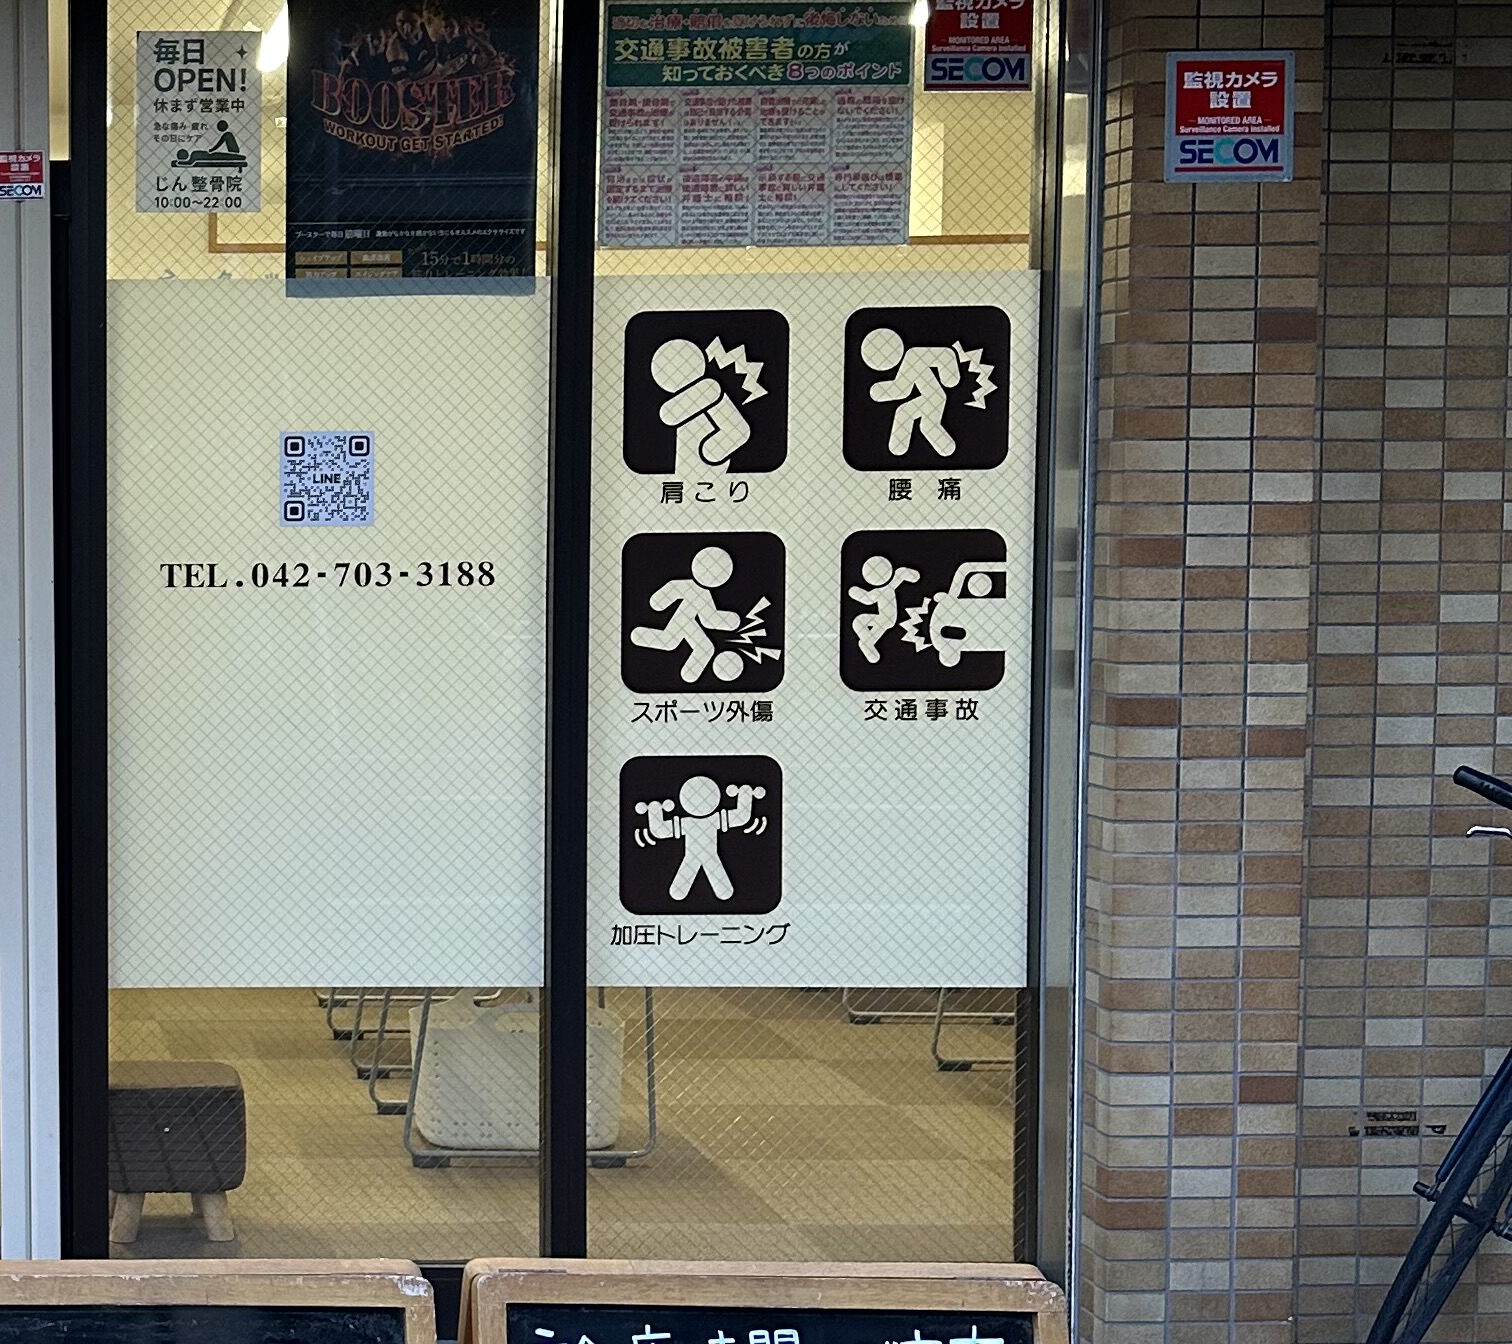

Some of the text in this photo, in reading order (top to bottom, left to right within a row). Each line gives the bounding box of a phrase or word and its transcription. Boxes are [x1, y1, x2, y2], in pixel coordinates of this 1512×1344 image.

[960, 12, 1000, 29] 設置
[153, 38, 205, 64] 毎日
[614, 36, 849, 62] 交通事故被害者の方が
[154, 68, 247, 92] OPEN!
[662, 62, 903, 83] 知っておくべき8つのポイント
[931, 57, 1025, 81] SECOM
[1183, 71, 1278, 89] 監視カメラ
[153, 98, 245, 113] 休まず営業中
[1209, 91, 1251, 108] 設置
[1197, 116, 1262, 124] MONITORED AREA
[1223, 125, 1249, 133] Camera
[323, 118, 397, 151] WORKOUT
[402, 137, 430, 153] GET
[1179, 138, 1278, 164] SECOM
[0, 185, 41, 196] SECOM
[156, 176, 243, 192] じん整骨院
[312, 473, 342, 484] LINE
[660, 480, 750, 504] 肩こり
[631, 700, 774, 723] スポーツ外傷
[863, 698, 979, 722] 交通事故
[610, 922, 791, 946] 加圧トレーニング
